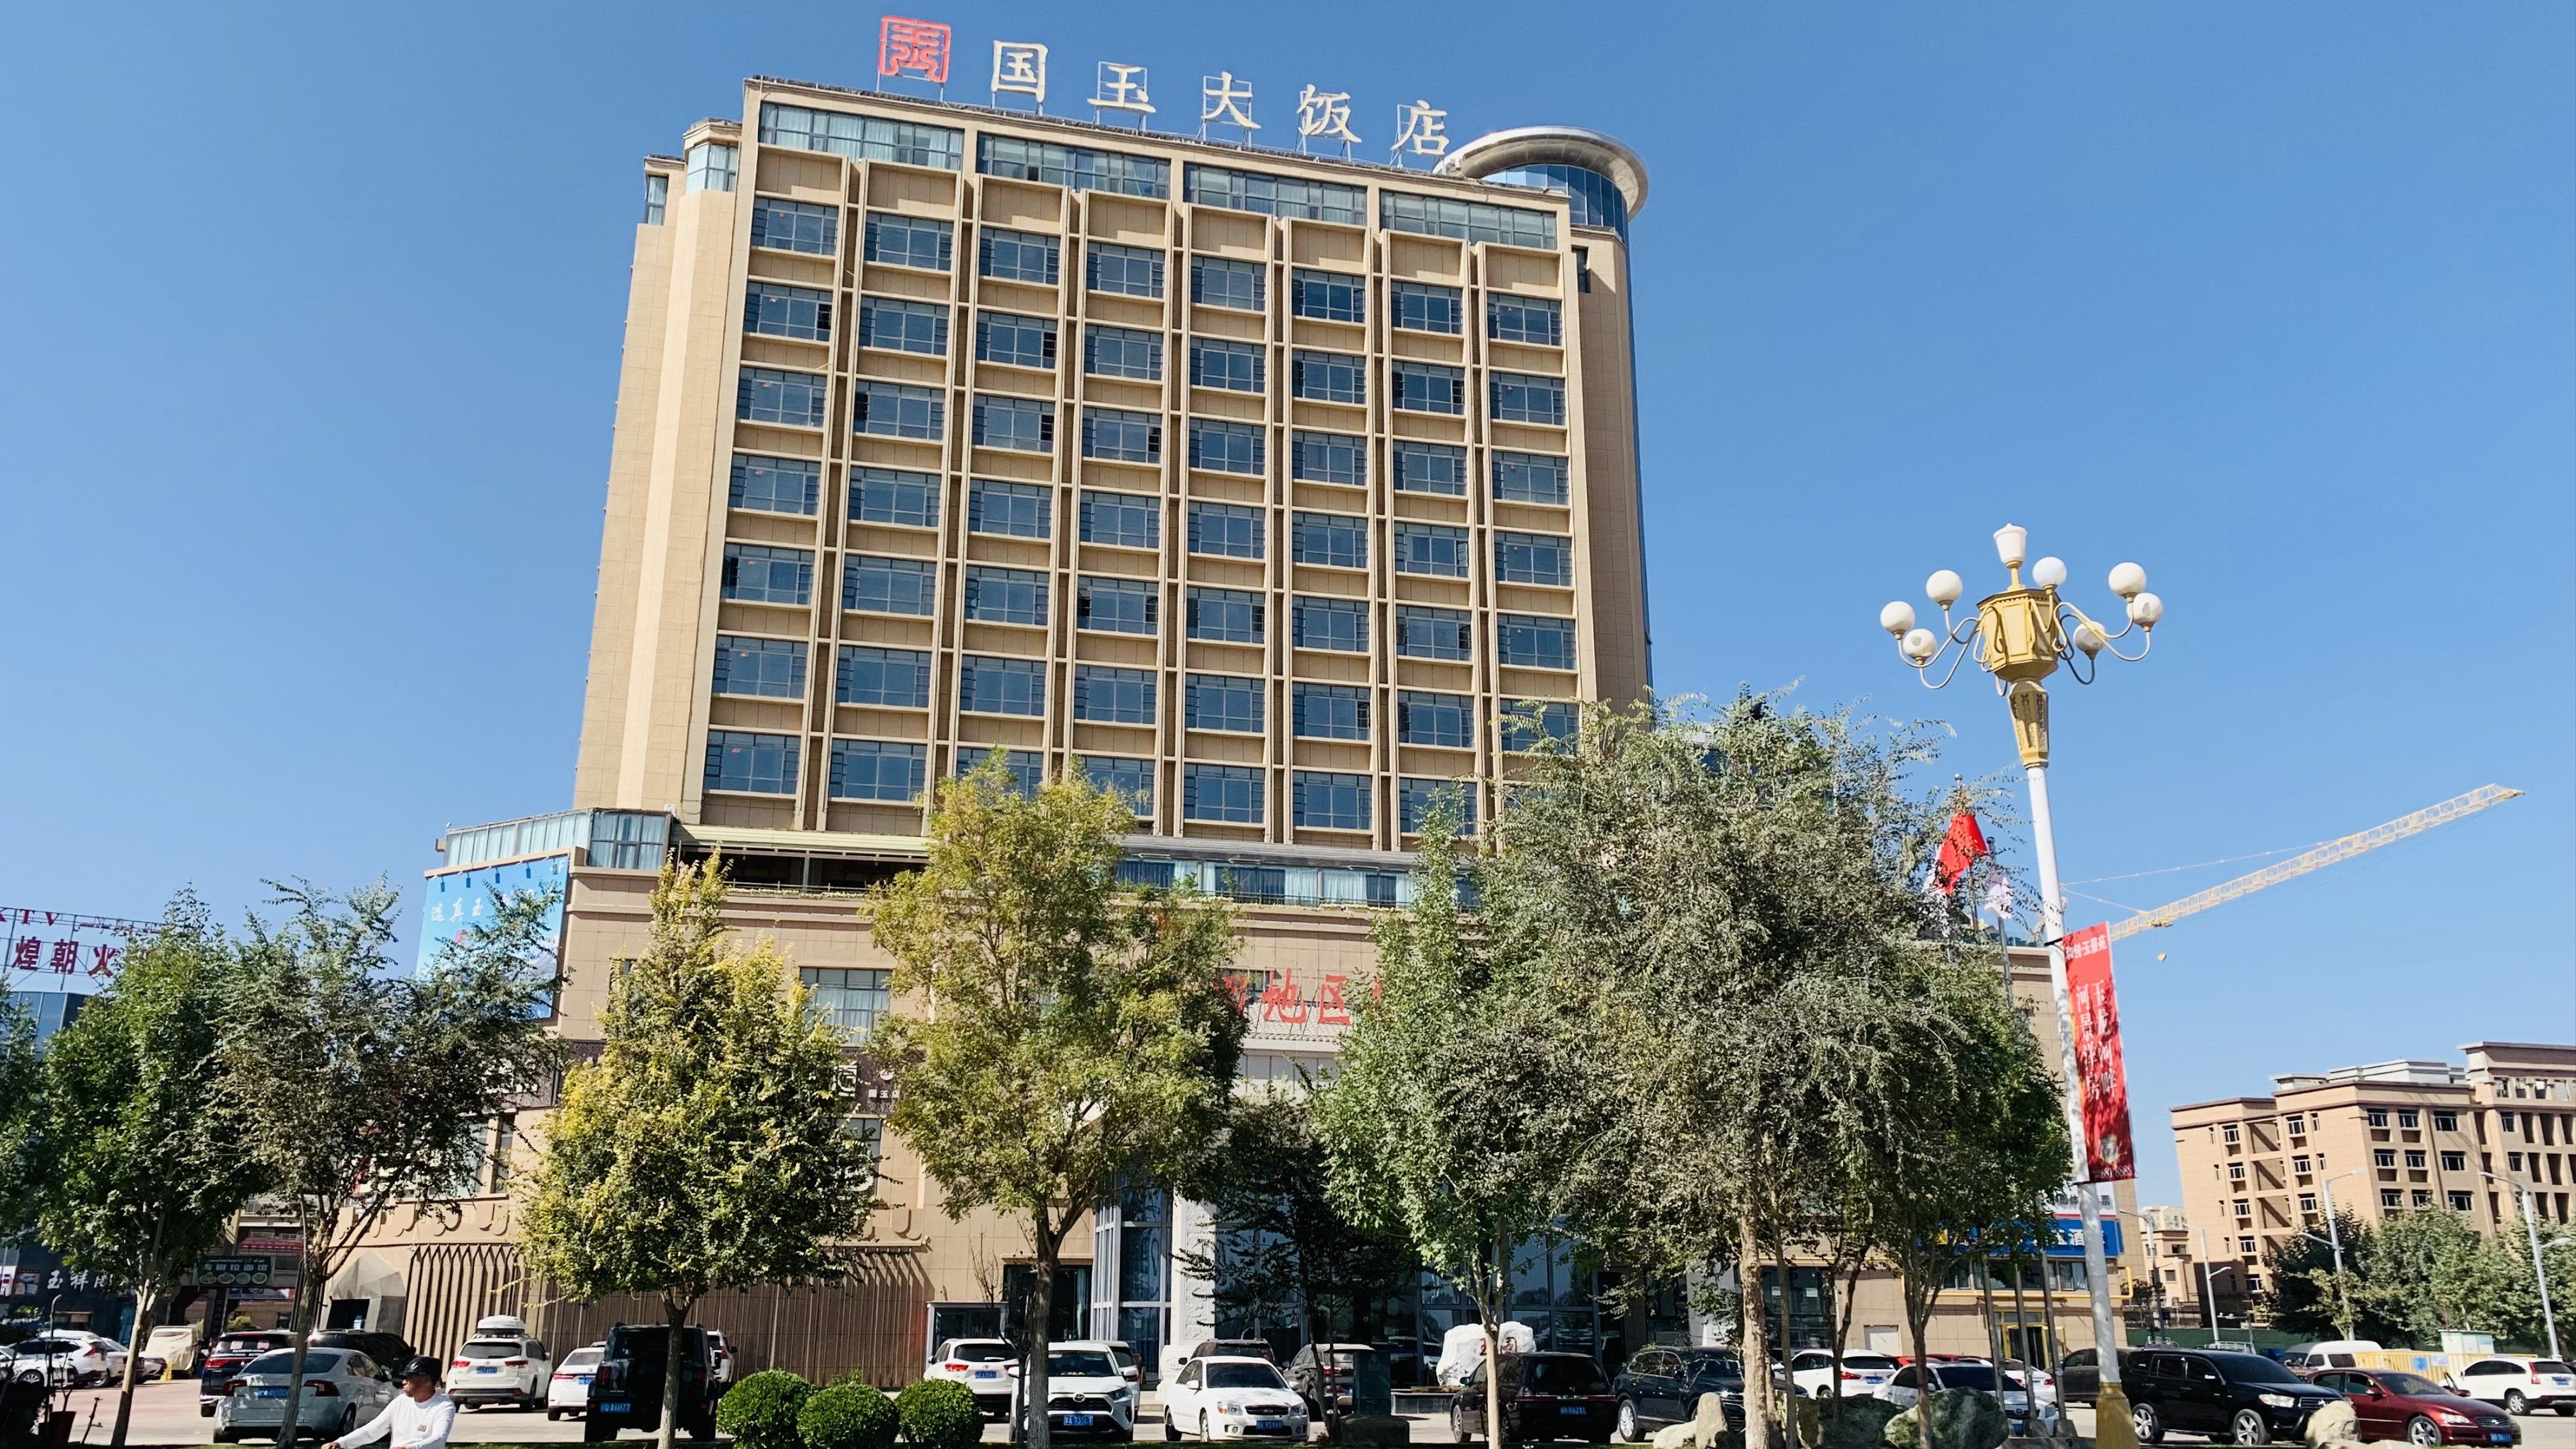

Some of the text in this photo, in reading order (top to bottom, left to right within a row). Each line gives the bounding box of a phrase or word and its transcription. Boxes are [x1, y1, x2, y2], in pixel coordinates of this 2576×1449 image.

[991, 40, 1448, 156] 国玉大饭店
[2076, 983, 2101, 1102] 河景洋房
